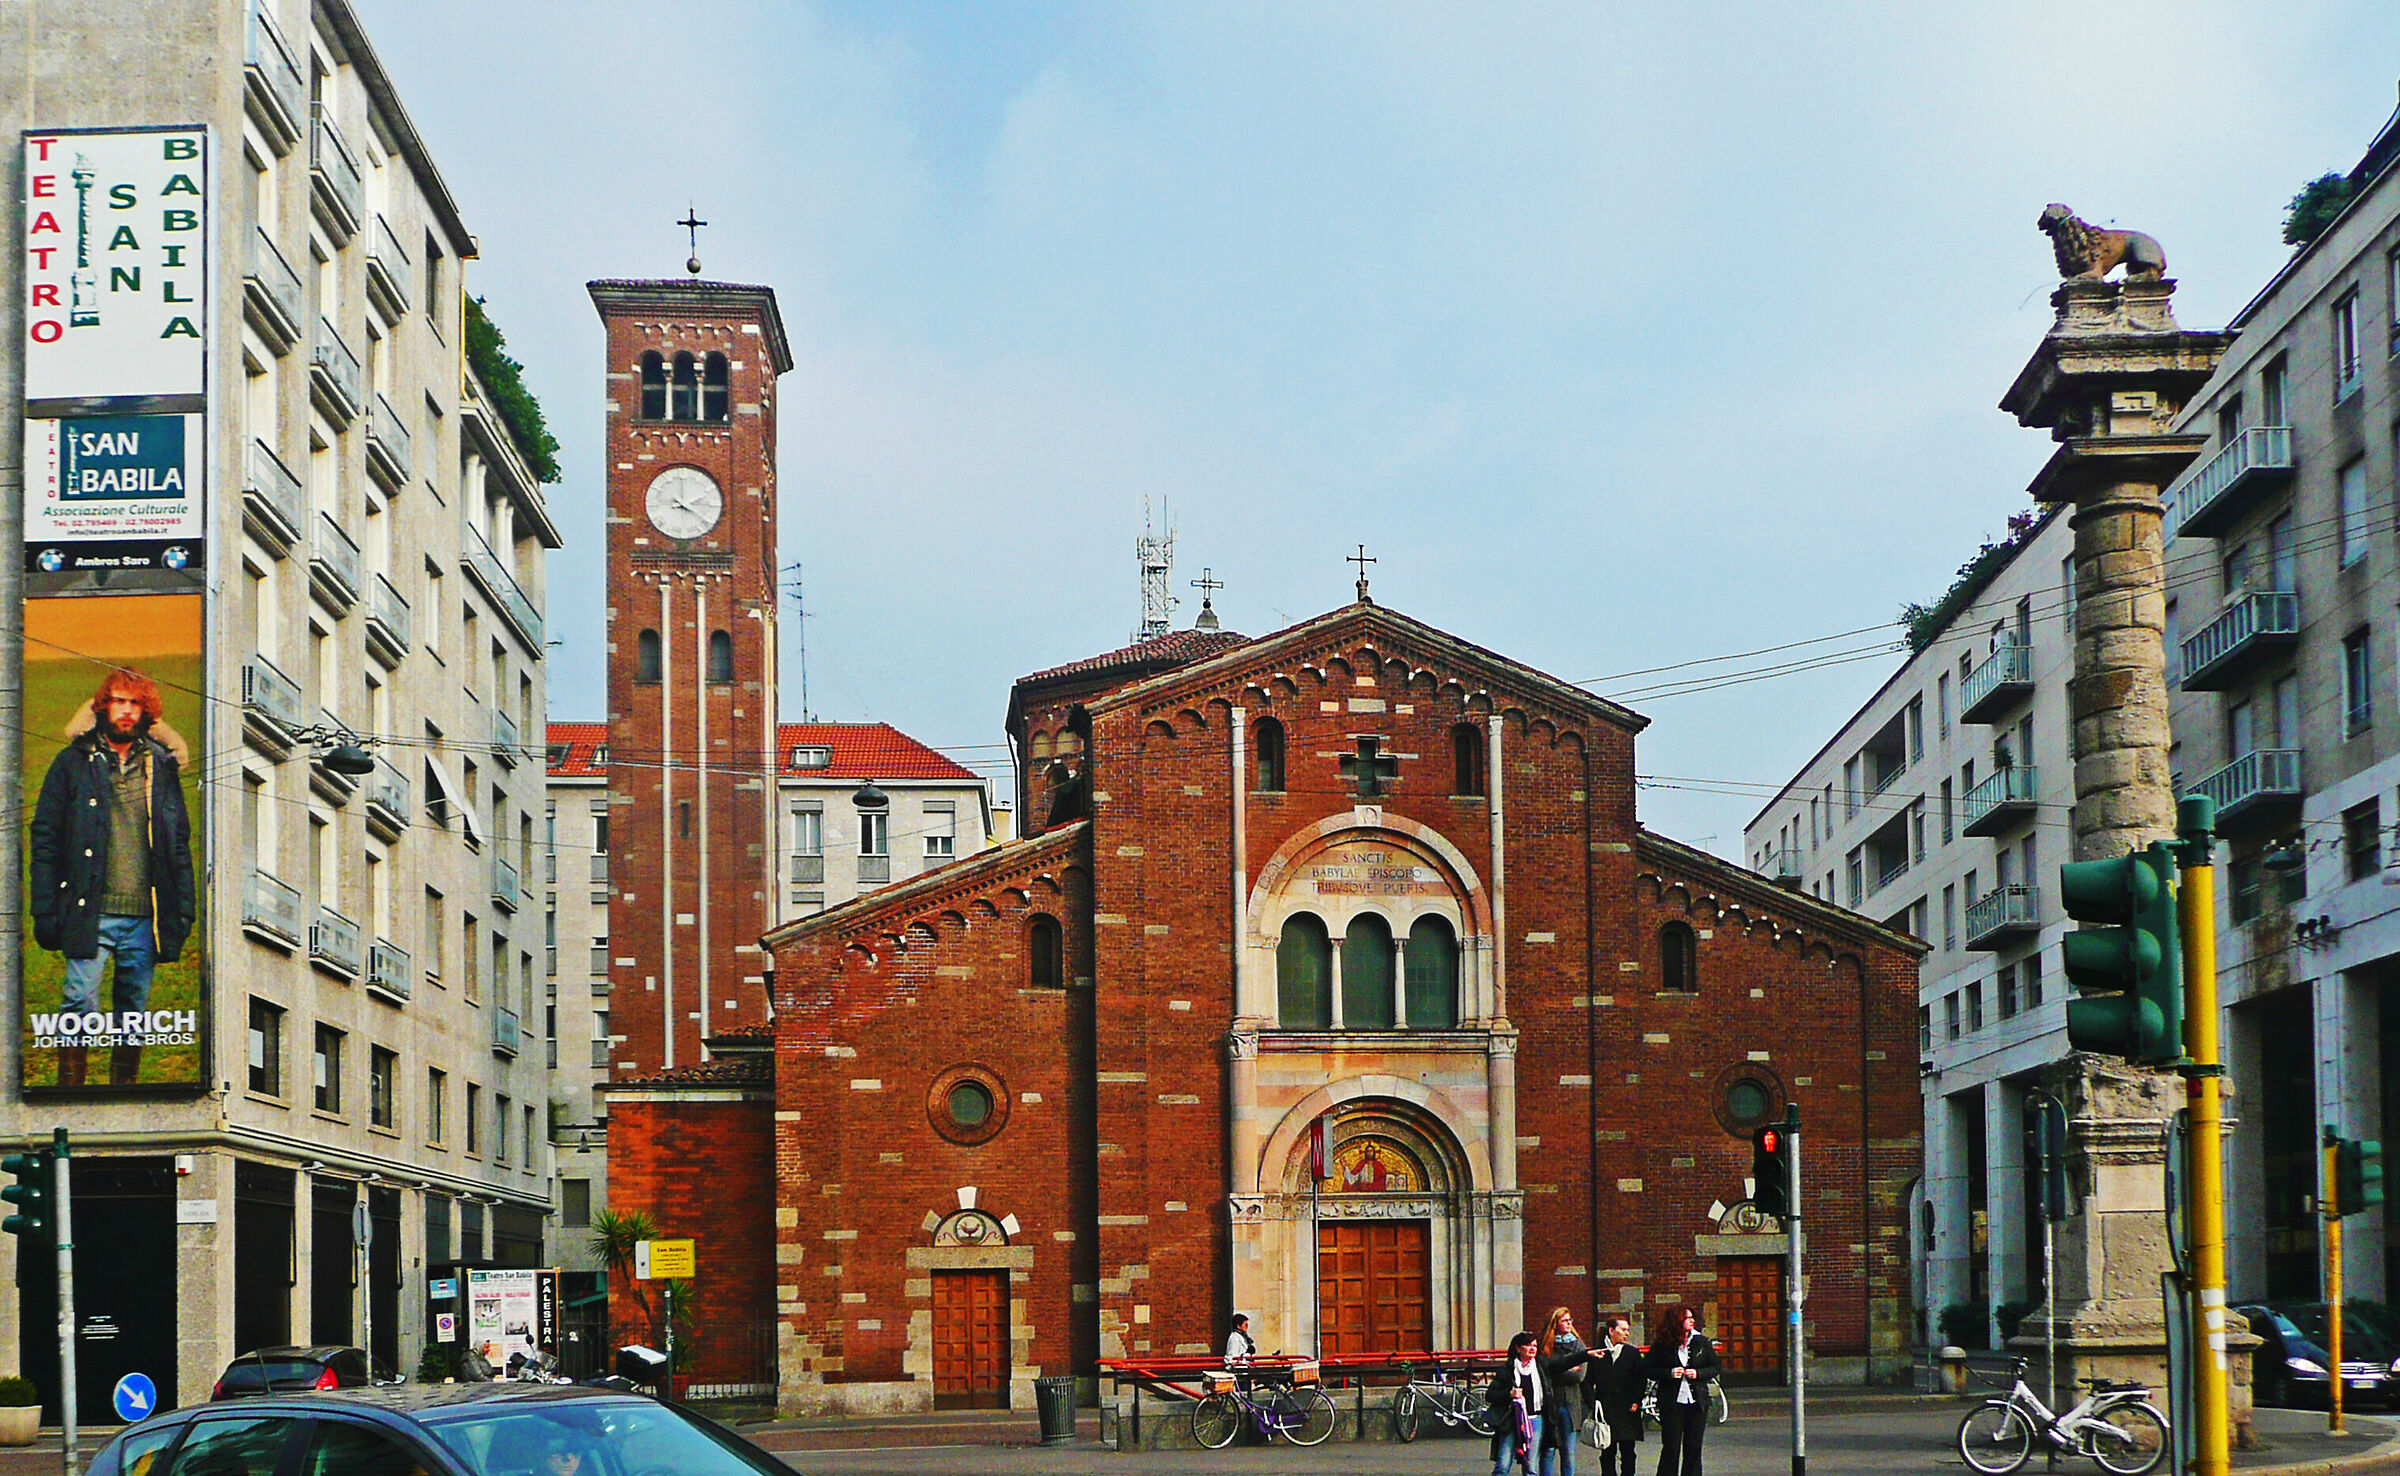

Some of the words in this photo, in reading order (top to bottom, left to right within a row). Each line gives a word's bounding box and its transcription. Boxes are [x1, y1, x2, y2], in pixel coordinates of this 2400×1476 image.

[30, 139, 63, 343] TEATRO
[108, 184, 141, 292] SAN
[160, 139, 200, 338] BABILA
[80, 432, 139, 456] SAN
[47, 419, 56, 498] TEATRO
[81, 467, 183, 492] BABILA
[42, 505, 125, 517] Associazione
[129, 503, 188, 515] Culturale
[1342, 853, 1393, 864] SANCTIS
[1367, 867, 1422, 879] EPISCOPO
[30, 1010, 196, 1036] WOOLRICH
[32, 1036, 78, 1048] JOHN
[81, 1034, 122, 1047] RICH
[127, 1033, 140, 1046] &
[542, 1277, 552, 1344] PALESTRA
